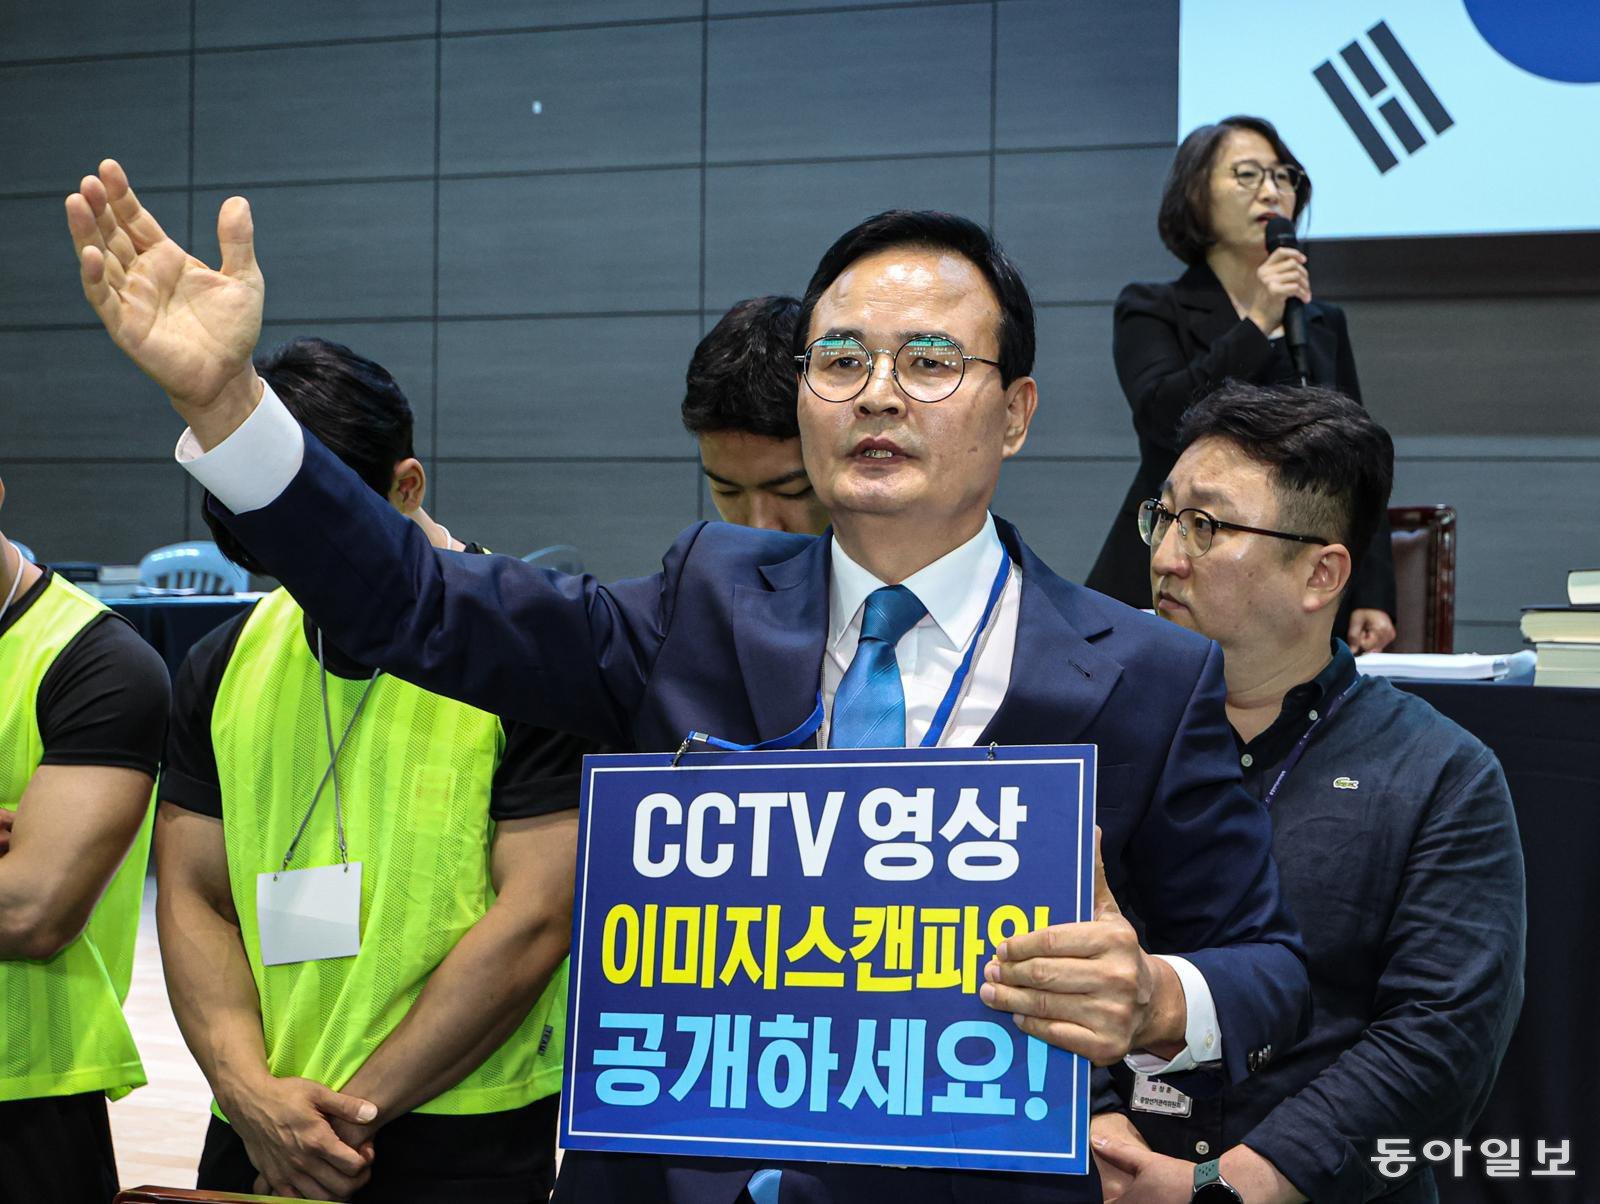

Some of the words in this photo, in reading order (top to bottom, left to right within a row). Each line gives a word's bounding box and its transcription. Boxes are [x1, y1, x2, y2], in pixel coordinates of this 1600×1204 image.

[632, 791, 846, 878] CCTV
[858, 786, 1028, 882] 영상
[592, 1012, 1049, 1122] 공개하세요!
